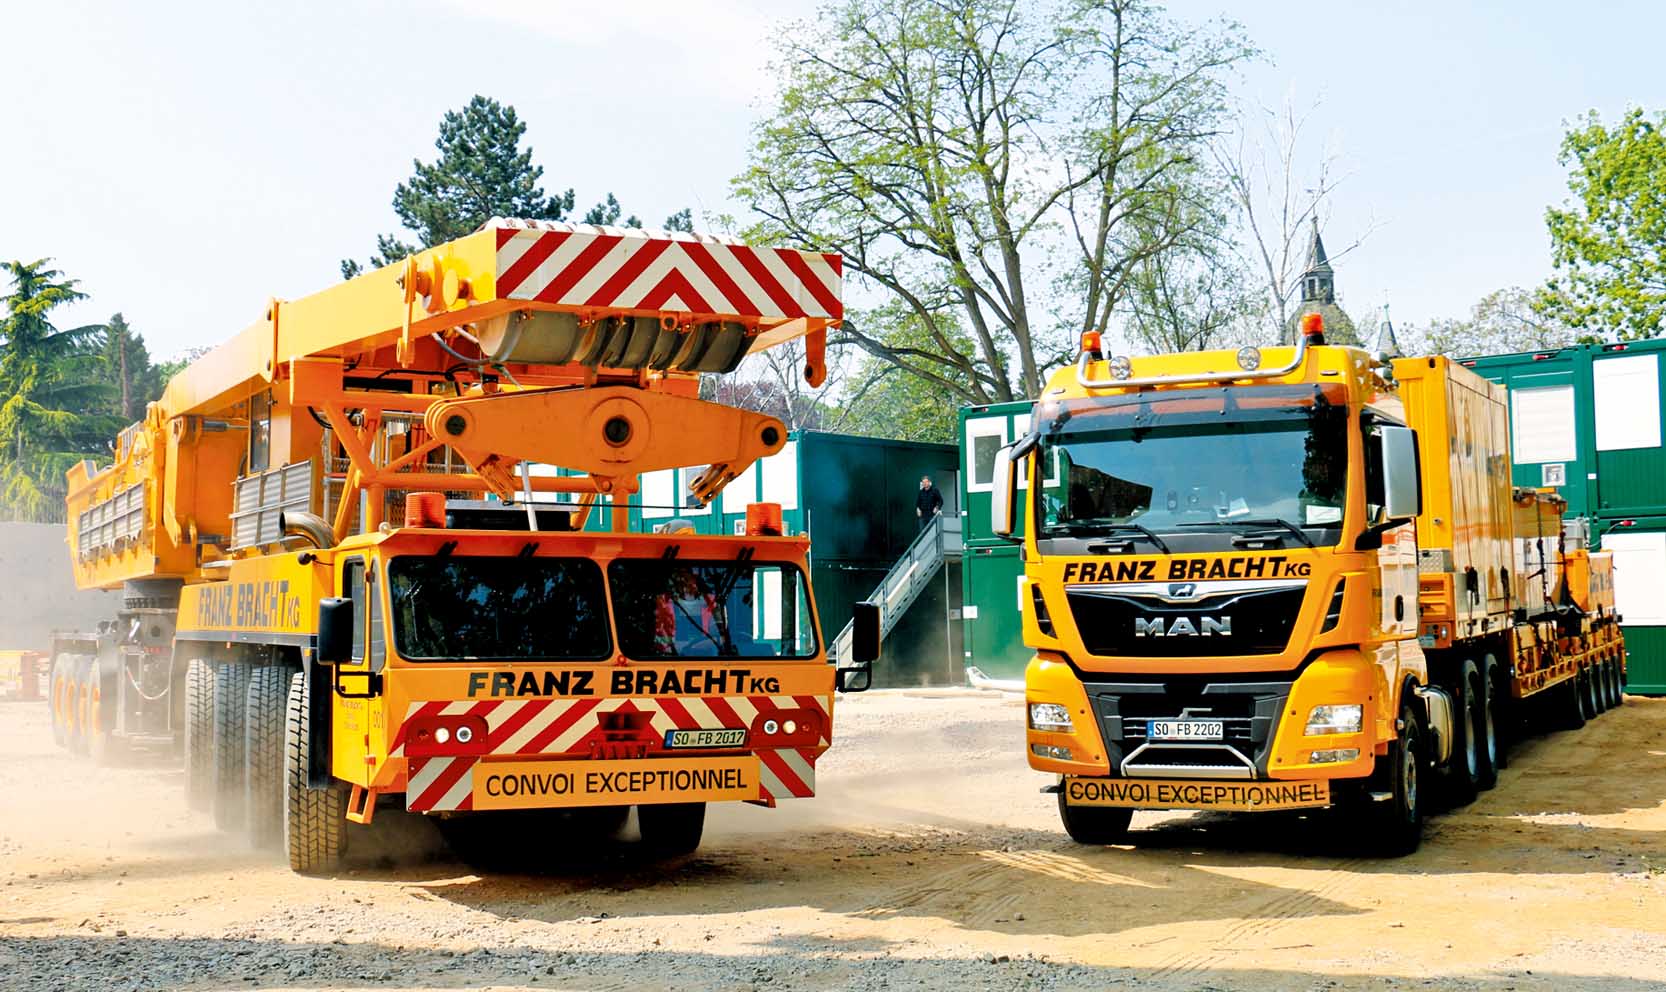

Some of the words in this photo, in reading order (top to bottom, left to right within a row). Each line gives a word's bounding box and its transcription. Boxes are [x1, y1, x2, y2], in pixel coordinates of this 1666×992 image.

[1063, 561, 1156, 582] FRANZ
[1168, 556, 1287, 579] BRACHT
[1284, 563, 1311, 576] KG
[198, 584, 232, 627] FRANZ
[237, 580, 289, 627] BRACHT
[1135, 616, 1231, 637] MAN
[467, 671, 594, 697] FRANZ
[610, 669, 751, 695] BRACHT
[750, 677, 780, 693] KG
[673, 732, 689, 746] SO
[697, 732, 713, 745] FB
[715, 730, 744, 745] 2017
[1154, 723, 1169, 736] SO
[1176, 723, 1191, 736] FB
[1193, 722, 1222, 736] 2202
[486, 773, 575, 797] CONVOI
[585, 768, 748, 794] EXCEPTIONNEL
[1069, 781, 1151, 801] CONVOI
[1157, 783, 1327, 806] EXCEPTIONNEL
